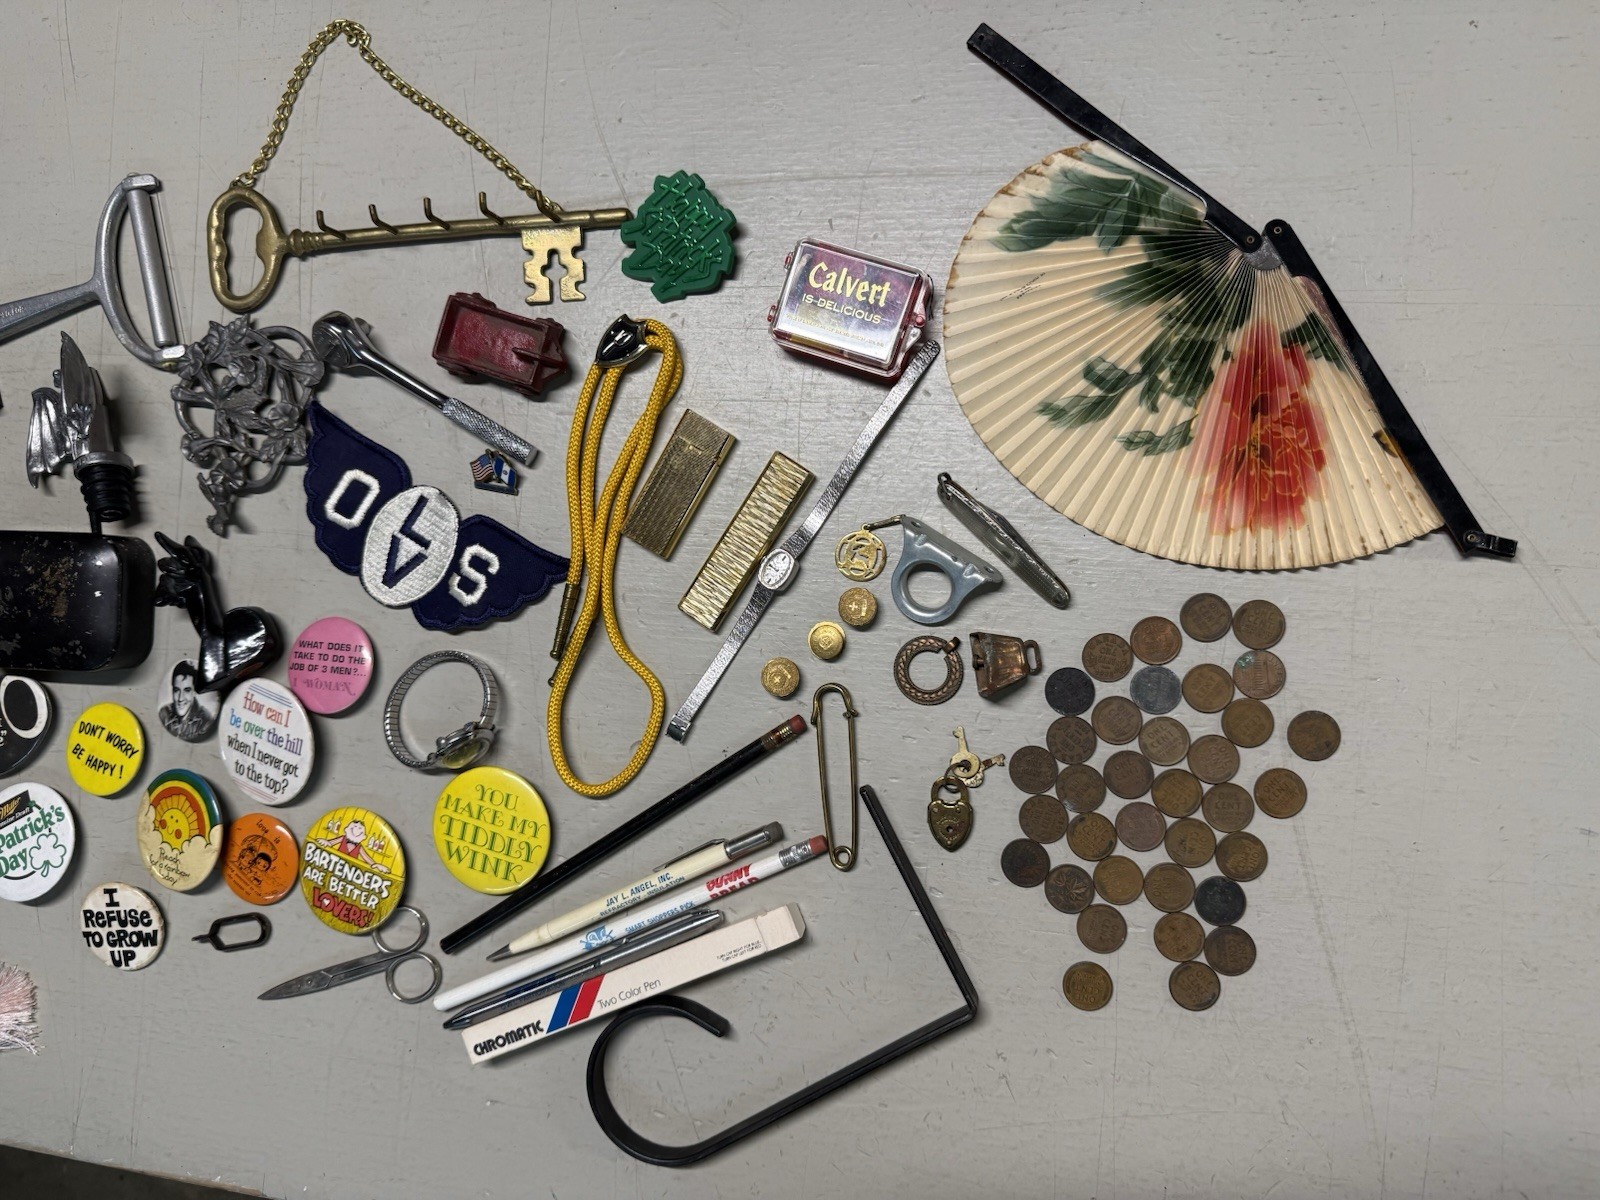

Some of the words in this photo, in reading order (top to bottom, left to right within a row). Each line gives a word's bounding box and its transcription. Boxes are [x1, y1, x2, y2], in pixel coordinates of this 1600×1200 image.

[808, 261, 891, 308] Calvert
[801, 293, 814, 304] IS
[817, 298, 882, 325] DELICIOUS
[294, 651, 314, 660] TAKE
[318, 653, 329, 661] TO
[332, 655, 345, 663] DO
[348, 656, 366, 665] THE
[298, 640, 324, 649] WHAT
[327, 642, 351, 651] DOES
[289, 662, 304, 671] JOB
[321, 665, 328, 673] 3
[243, 691, 265, 715] How
[266, 707, 284, 725] can
[284, 710, 291, 727] I
[78, 721, 105, 739] DON'T
[105, 731, 139, 759] WORRY
[230, 708, 241, 728] be
[243, 720, 266, 739] over
[267, 727, 284, 747] the
[284, 733, 303, 756] hill
[72, 743, 86, 760] BE
[85, 754, 117, 777] HAPPY
[227, 733, 251, 756] when
[251, 742, 258, 758] I
[257, 749, 283, 770] never
[283, 761, 299, 777] got
[235, 760, 245, 775] to
[247, 763, 262, 784] the
[265, 774, 289, 794] top?
[475, 784, 520, 812] YOU
[443, 794, 505, 827] MAKE
[509, 815, 547, 838] MY
[440, 814, 542, 864] TIDDLY
[304, 842, 392, 899] BARTENDERS
[444, 839, 523, 883] WINK
[103, 888, 120, 907] I
[303, 866, 326, 886] ARE
[329, 876, 379, 910] BETTER
[600, 895, 641, 917] REFRACTORY
[647, 876, 685, 897] INSULATION
[606, 895, 619, 907] JAY
[621, 891, 631, 902] L.
[630, 880, 658, 897] ANGEL,
[658, 872, 674, 884] INC.
[312, 886, 374, 928] LOVERS!
[625, 921, 647, 934] SMART
[647, 908, 678, 926] SHOPPERS
[679, 901, 696, 912] PICK
[82, 931, 104, 948] TO
[106, 929, 158, 948] GROW
[110, 950, 136, 968] UP
[598, 995, 618, 1010] Two
[618, 985, 643, 1001] Color
[643, 978, 662, 992] Pen
[473, 1019, 545, 1056] CHROMATIC
